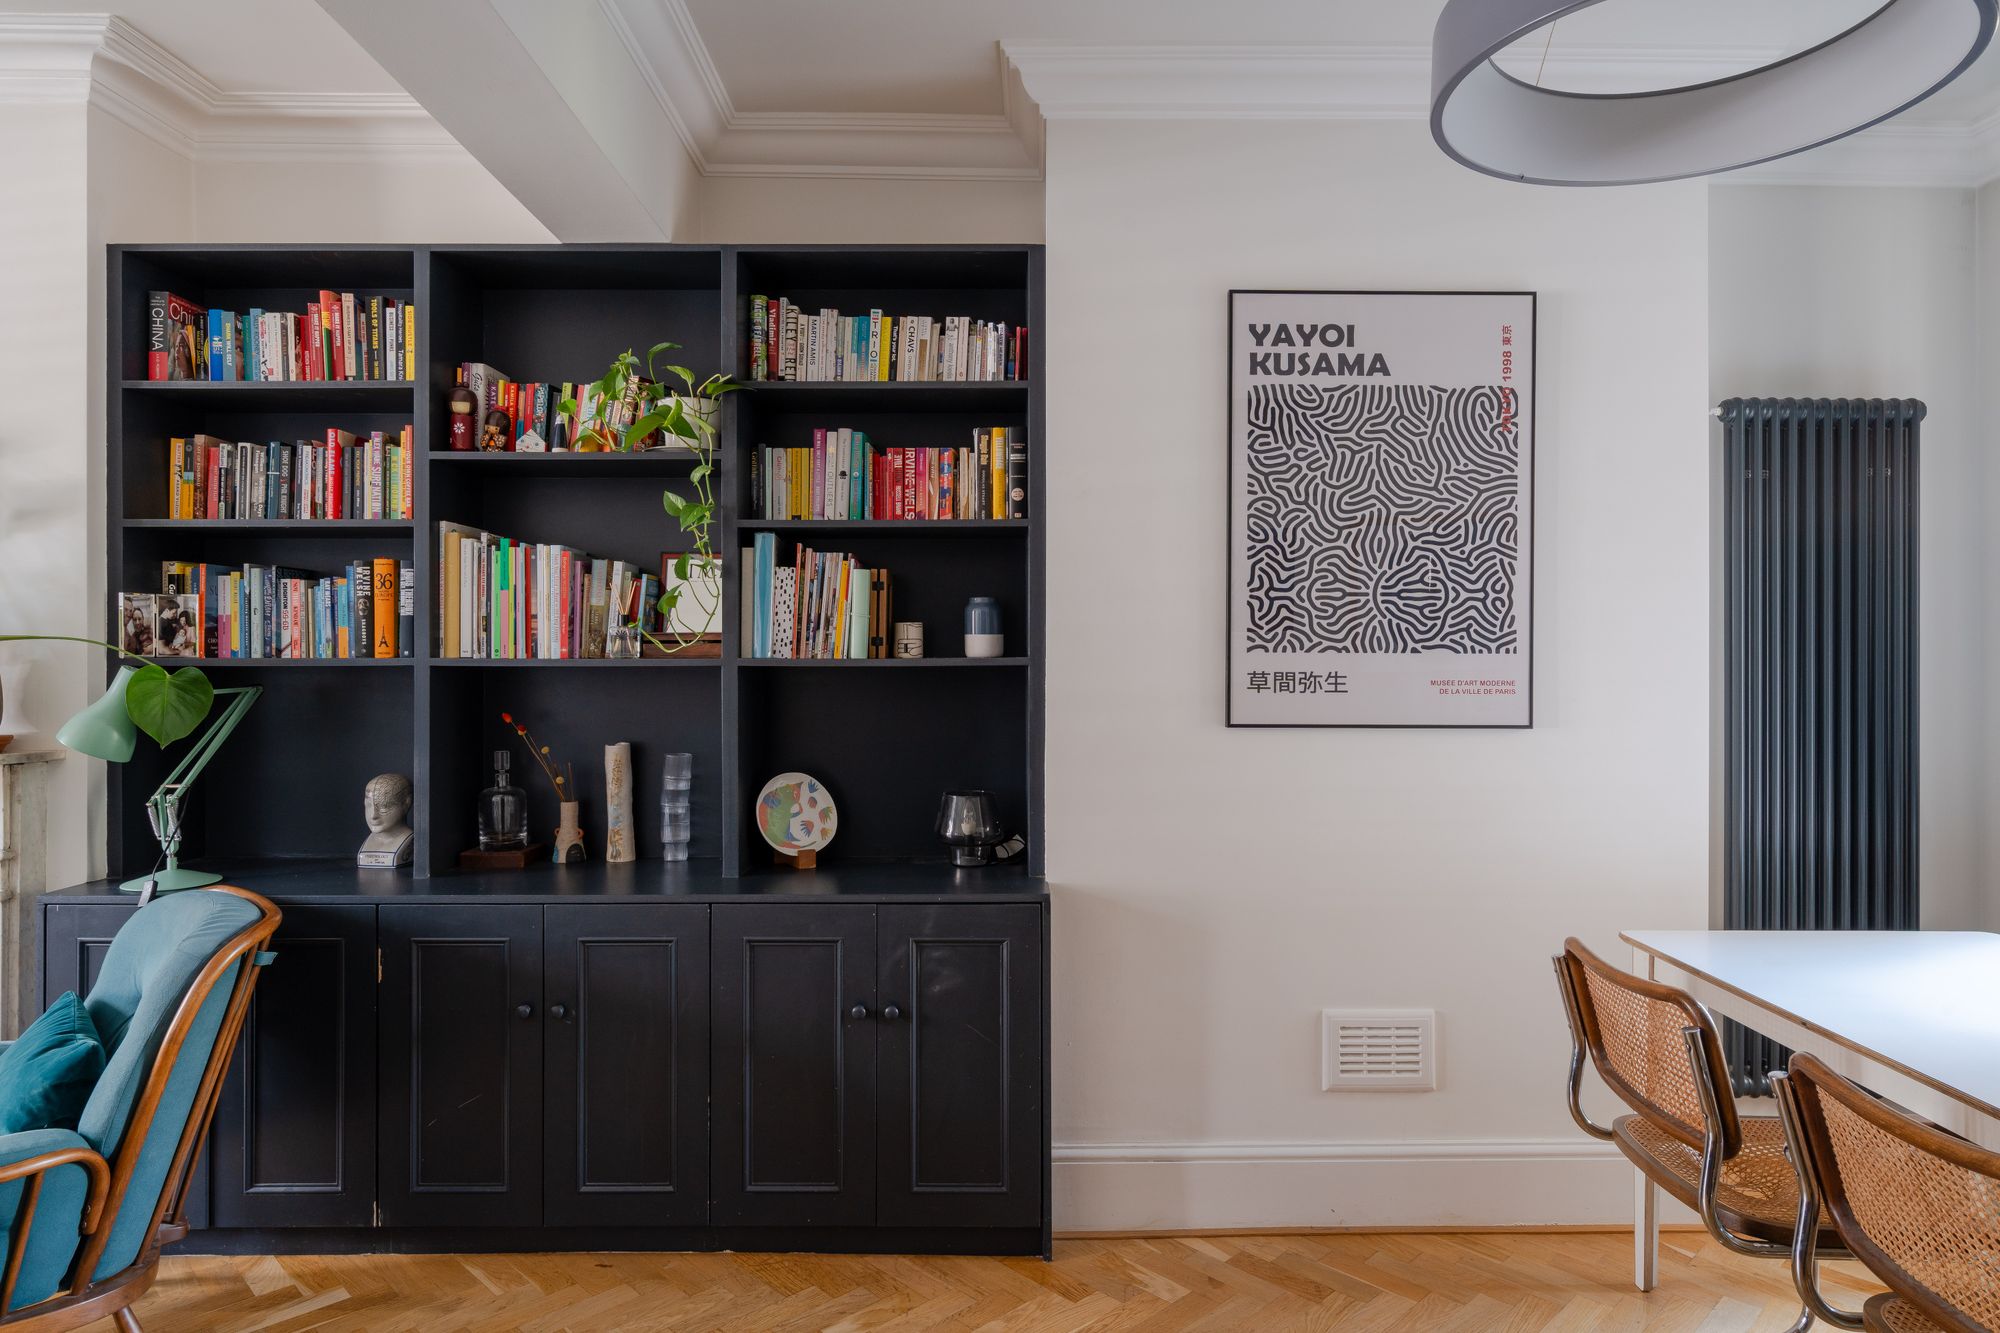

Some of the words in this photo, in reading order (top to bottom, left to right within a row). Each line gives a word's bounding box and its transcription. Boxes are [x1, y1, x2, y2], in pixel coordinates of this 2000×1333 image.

[372, 319, 378, 327] OF
[753, 299, 762, 324] MAGGIE
[152, 307, 164, 351] CHINA
[768, 308, 777, 346] Vladimir
[785, 308, 797, 342] KILEY
[1248, 323, 1355, 347] YAYOI
[1502, 325, 1511, 346] 東京
[907, 325, 916, 353] CHAVS
[785, 358, 797, 381] REI
[1249, 352, 1391, 377] KUSAMA
[1502, 351, 1511, 381] 1998
[472, 372, 483, 391] Guts
[490, 386, 498, 405] KATE
[373, 437, 381, 450] ALEX
[281, 450, 289, 465] SHOE
[373, 450, 381, 466] WADE
[904, 447, 916, 486] IRVINE
[826, 471, 834, 507] OUTLIERS
[324, 581, 332, 590] RAY
[356, 566, 364, 597] WELSH
[363, 566, 371, 598] IRVINE
[375, 573, 393, 591] 36
[405, 568, 414, 587] LOUIS
[324, 590, 332, 608] MEARS
[405, 588, 414, 617] THEROUX
[1247, 671, 1349, 694] 草間弥生
